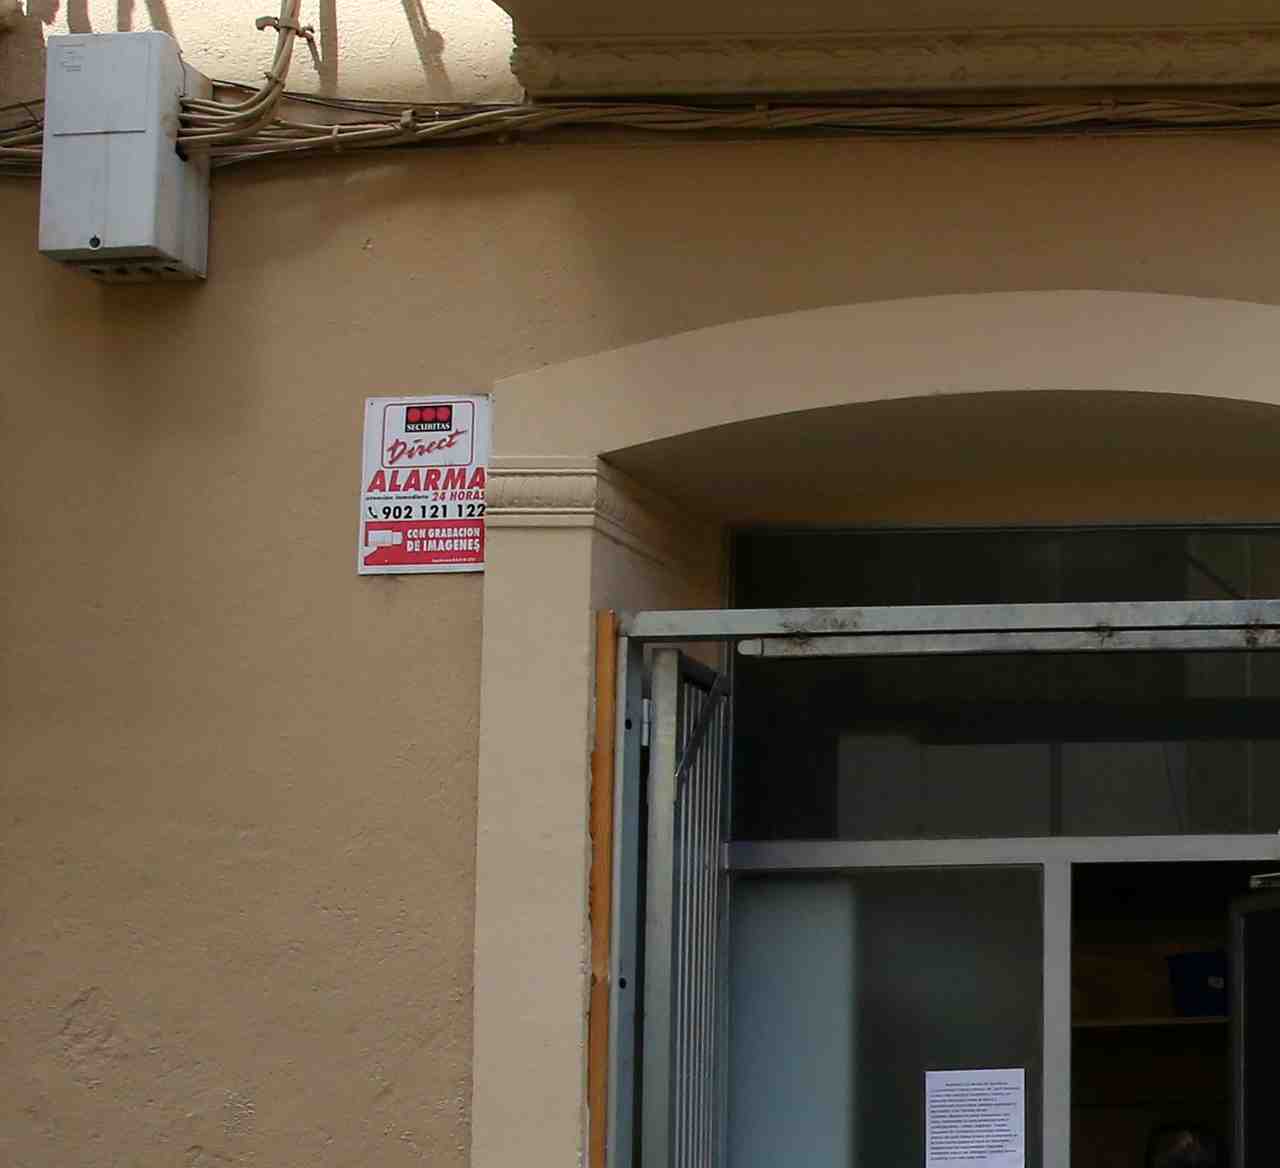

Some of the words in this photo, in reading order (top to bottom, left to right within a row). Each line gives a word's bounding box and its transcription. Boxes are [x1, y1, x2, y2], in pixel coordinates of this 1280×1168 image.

[406, 422, 450, 431] SECURITAS
[387, 429, 468, 465] Direct
[367, 466, 486, 493] ALARMA
[432, 491, 446, 502] 24
[382, 505, 413, 519] 902
[421, 503, 448, 519] 121
[457, 503, 486, 518] 122
[407, 528, 426, 539] CON
[428, 526, 480, 538] GRABACION
[406, 540, 421, 552] DE
[423, 538, 480, 553] IMAGENES
